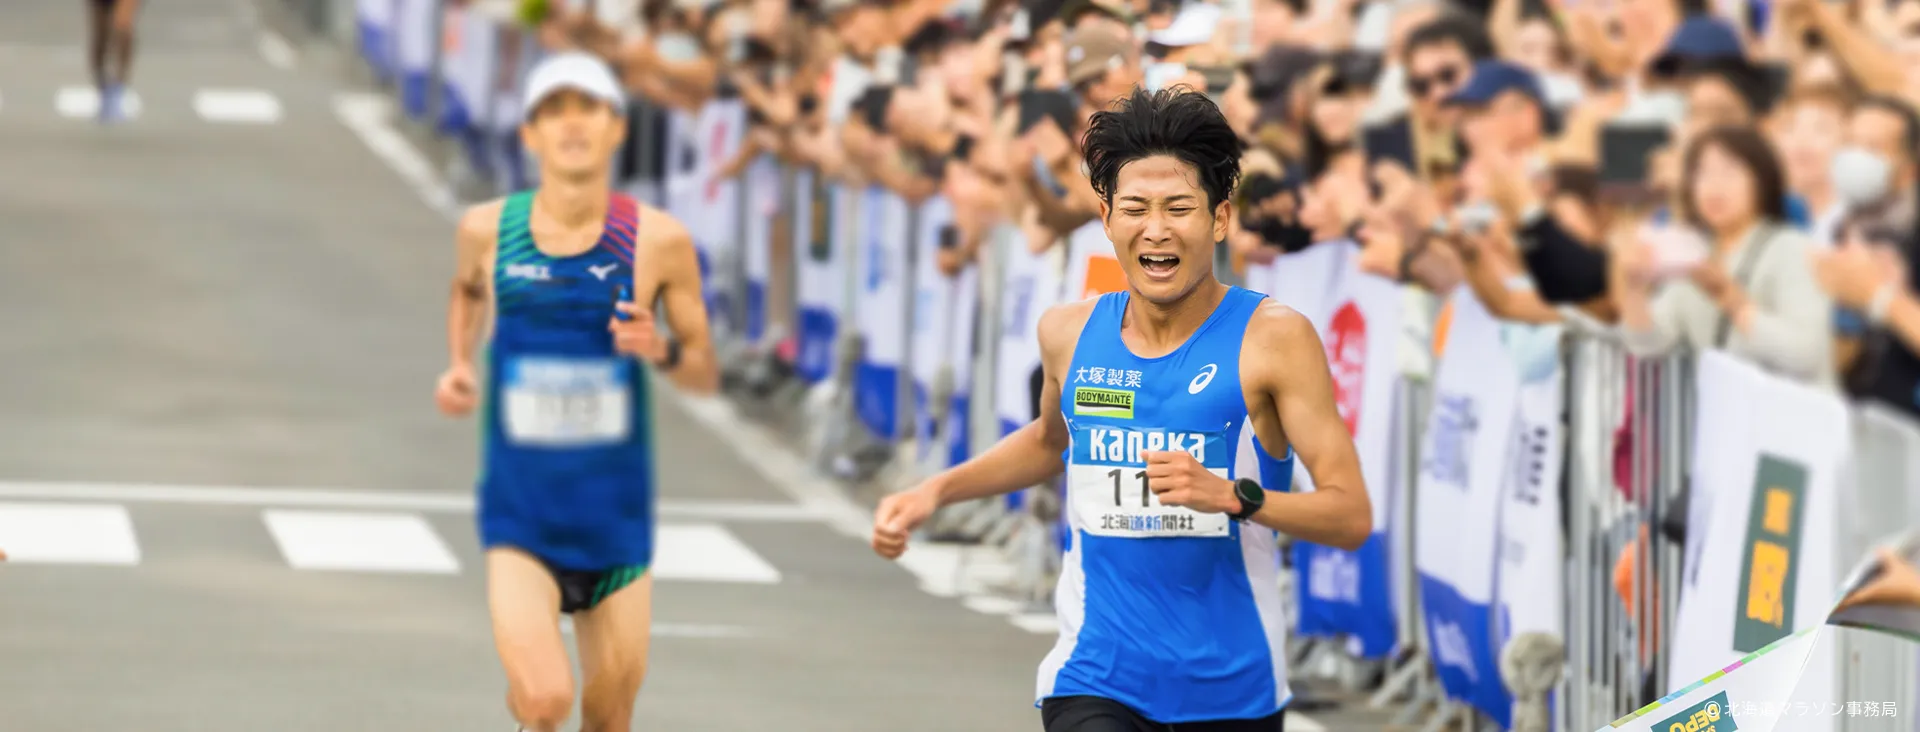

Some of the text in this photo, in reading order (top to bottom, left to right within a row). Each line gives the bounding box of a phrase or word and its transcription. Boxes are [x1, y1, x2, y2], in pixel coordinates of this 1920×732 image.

[1074, 366, 1143, 388] 大塚製薬
[1107, 469, 1150, 507] 11
[1101, 513, 1195, 531] 北海道新聞社
